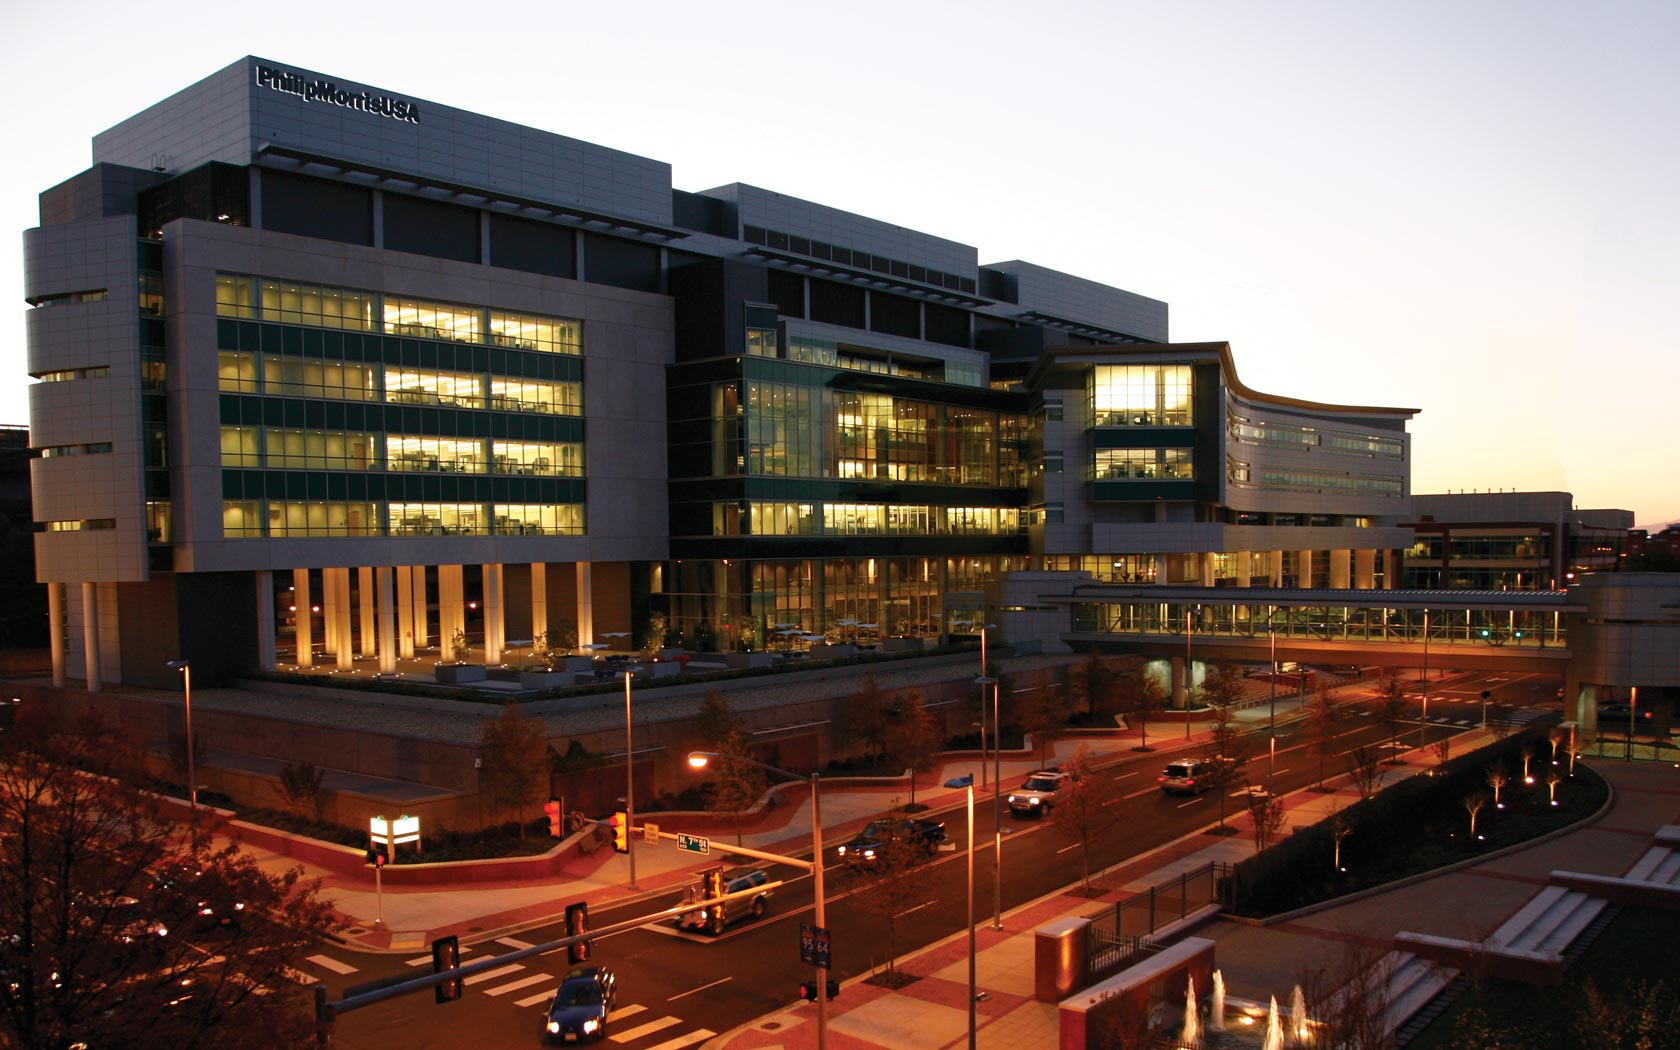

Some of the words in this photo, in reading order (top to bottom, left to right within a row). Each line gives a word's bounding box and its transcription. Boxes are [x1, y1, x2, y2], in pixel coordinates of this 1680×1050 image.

[699, 839, 706, 848] St
[802, 937, 814, 950] 95
[818, 942, 828, 954] 64
